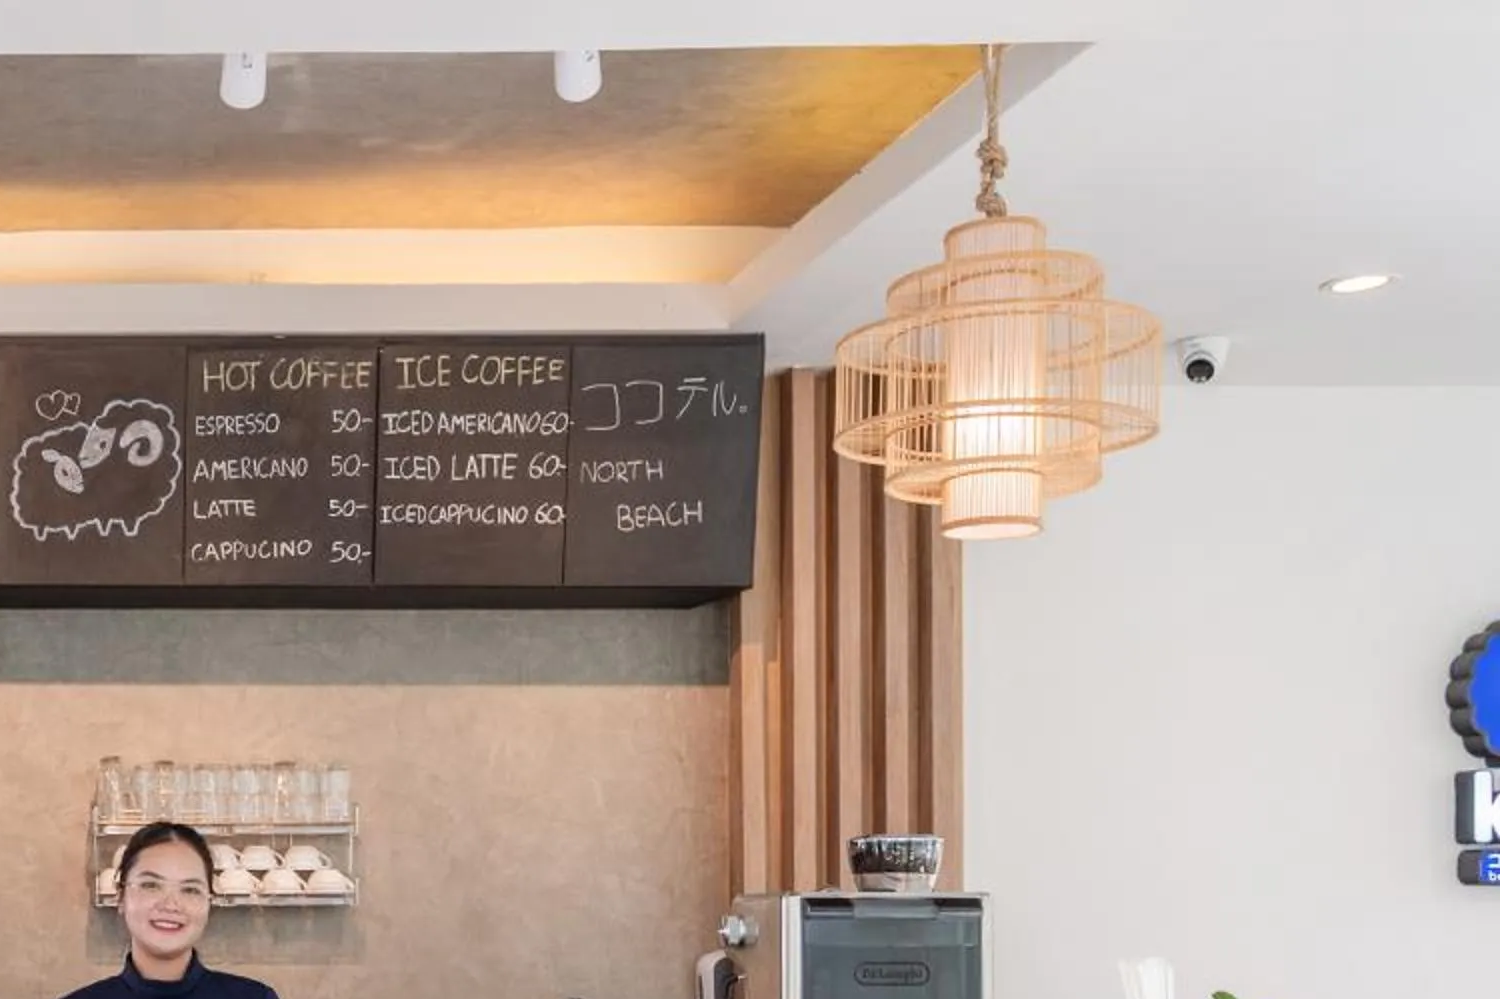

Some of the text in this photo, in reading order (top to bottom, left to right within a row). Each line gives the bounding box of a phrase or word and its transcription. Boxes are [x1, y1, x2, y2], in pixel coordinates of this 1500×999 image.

[203, 352, 373, 393] HOT COFFEE
[396, 354, 565, 389] ICE COFFEE
[195, 413, 281, 436] ESPRESSO
[192, 456, 309, 482] AMERICANO
[384, 455, 441, 482] ICED
[451, 453, 518, 481] LATTE
[580, 459, 665, 484] NORTH
[193, 499, 257, 519] LATTE
[616, 500, 703, 533] BEACH
[191, 538, 313, 561] CAPPUCINO
